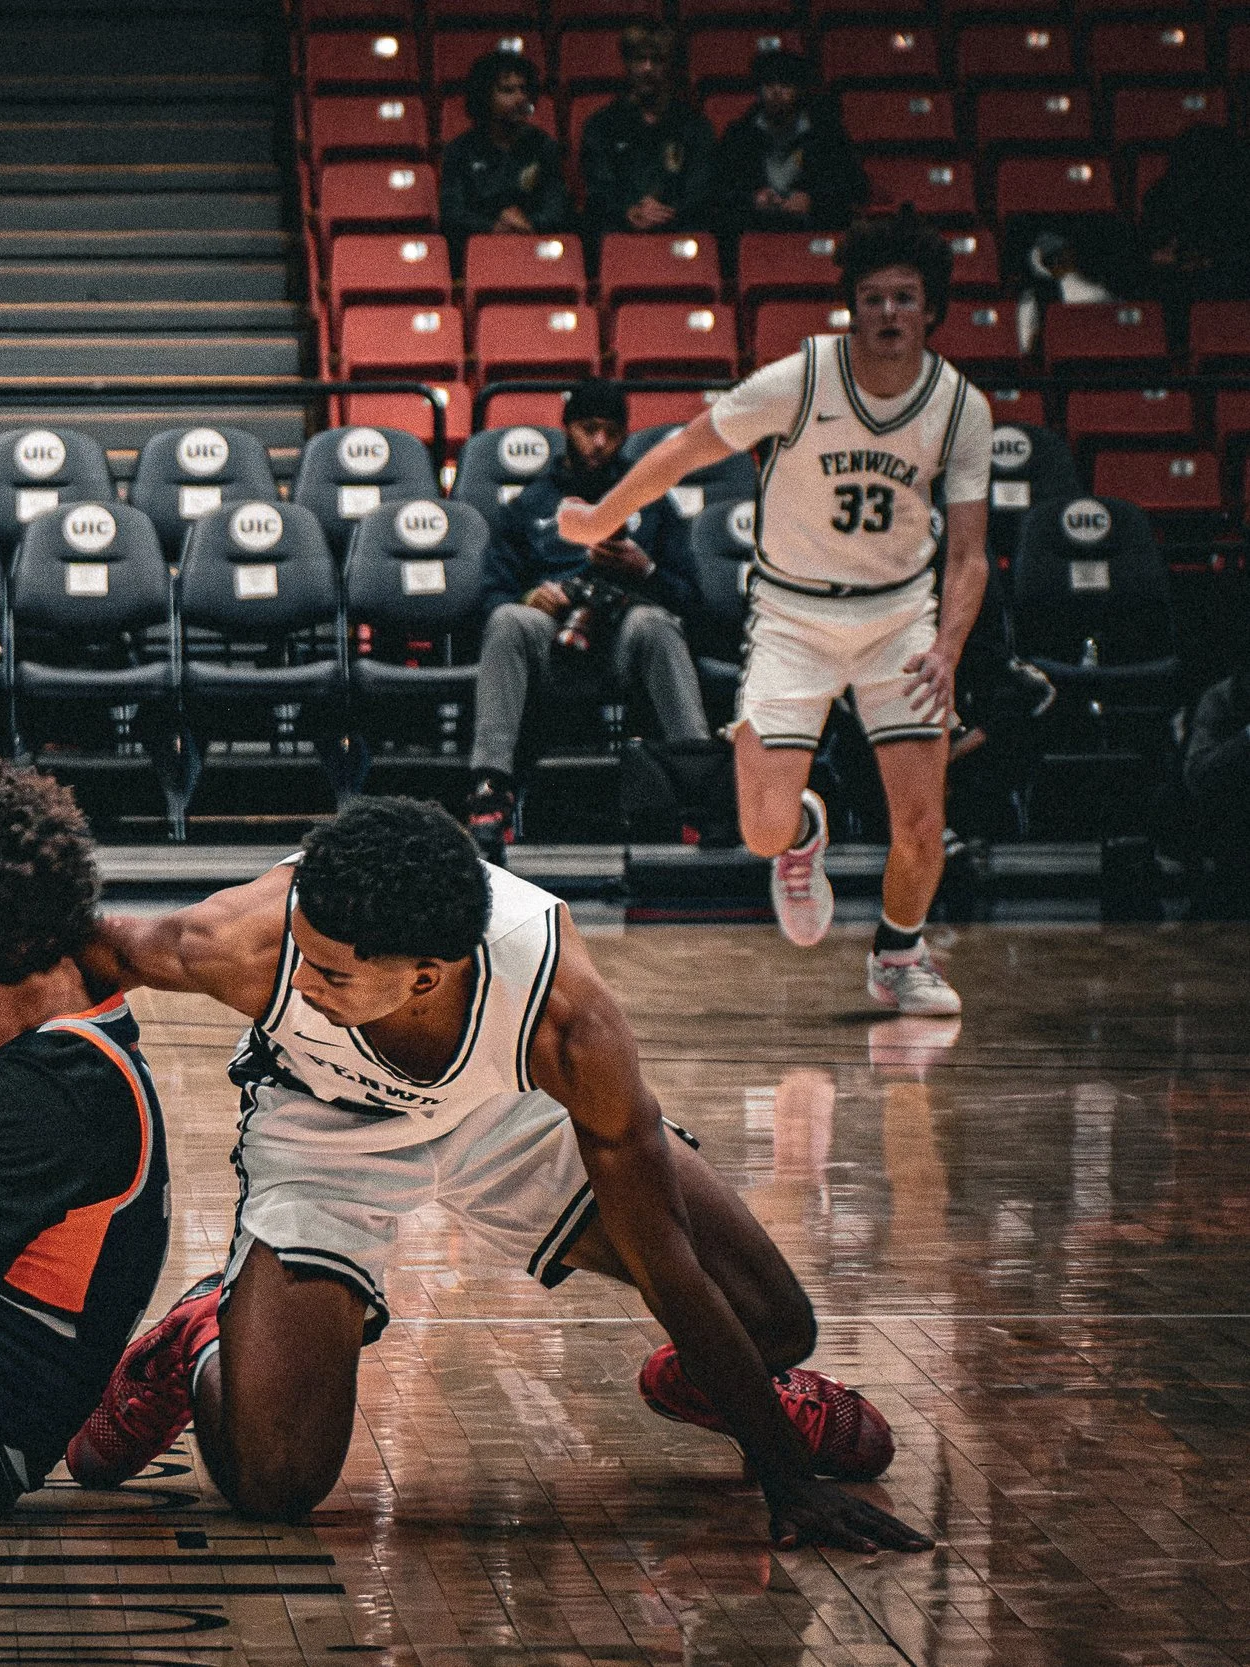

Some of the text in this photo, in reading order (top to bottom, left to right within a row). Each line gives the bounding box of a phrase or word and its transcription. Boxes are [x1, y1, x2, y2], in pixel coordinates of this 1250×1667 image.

[23, 447, 59, 462] UIC
[186, 443, 222, 459] UIC
[348, 444, 383, 459] UIC
[508, 443, 544, 458] UIC
[991, 440, 1026, 456] UIC
[831, 483, 895, 534] 33
[71, 521, 108, 536] UIC
[239, 519, 276, 534] UIC
[404, 516, 442, 531] UIC
[1068, 513, 1106, 530] UIC
